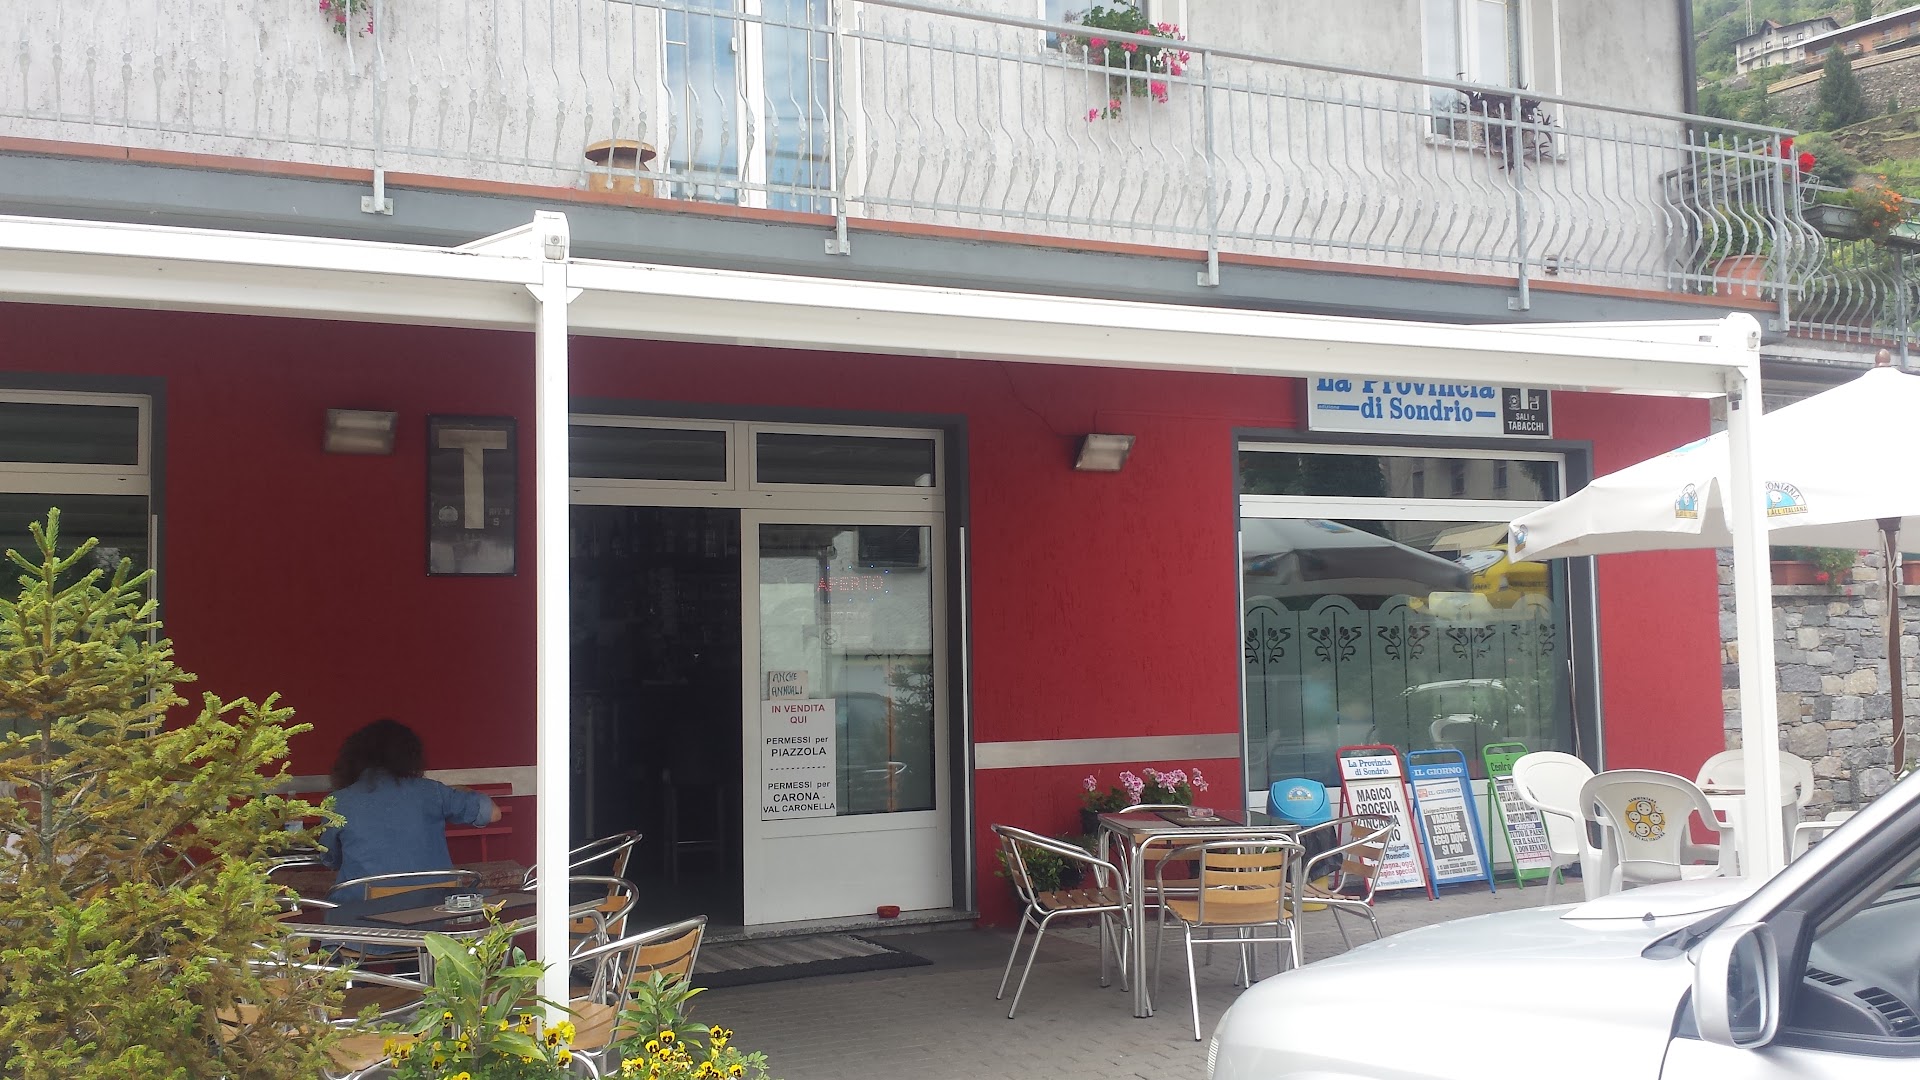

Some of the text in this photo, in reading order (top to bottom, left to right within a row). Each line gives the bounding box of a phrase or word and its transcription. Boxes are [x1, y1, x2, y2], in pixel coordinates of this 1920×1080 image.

[1361, 396, 1473, 422] di Sondrio
[1515, 412, 1530, 421] SALI
[1508, 420, 1544, 432] TABACCHI
[438, 429, 508, 529] T
[817, 575, 884, 592] APERTO
[772, 671, 798, 683] ANCHE
[771, 684, 803, 697] ANNUALI
[771, 704, 826, 713] IN VENDITA
[790, 716, 807, 724] QUI
[766, 736, 829, 745] PERMESSI per
[771, 747, 827, 757] PIAZZOLA
[1347, 758, 1392, 768] La Provincia
[1363, 767, 1389, 776] Sondrio
[1413, 766, 1462, 777] IL GIORNO
[768, 781, 831, 790] PERMESSI per
[773, 792, 820, 802] CARONA
[1356, 787, 1392, 802] MAGICO
[763, 802, 835, 813] VAL CARONELLA
[1356, 800, 1401, 815] CROCEVIA
[1431, 812, 1459, 824] VACANZE
[1433, 832, 1468, 846] ECCO DOVE
